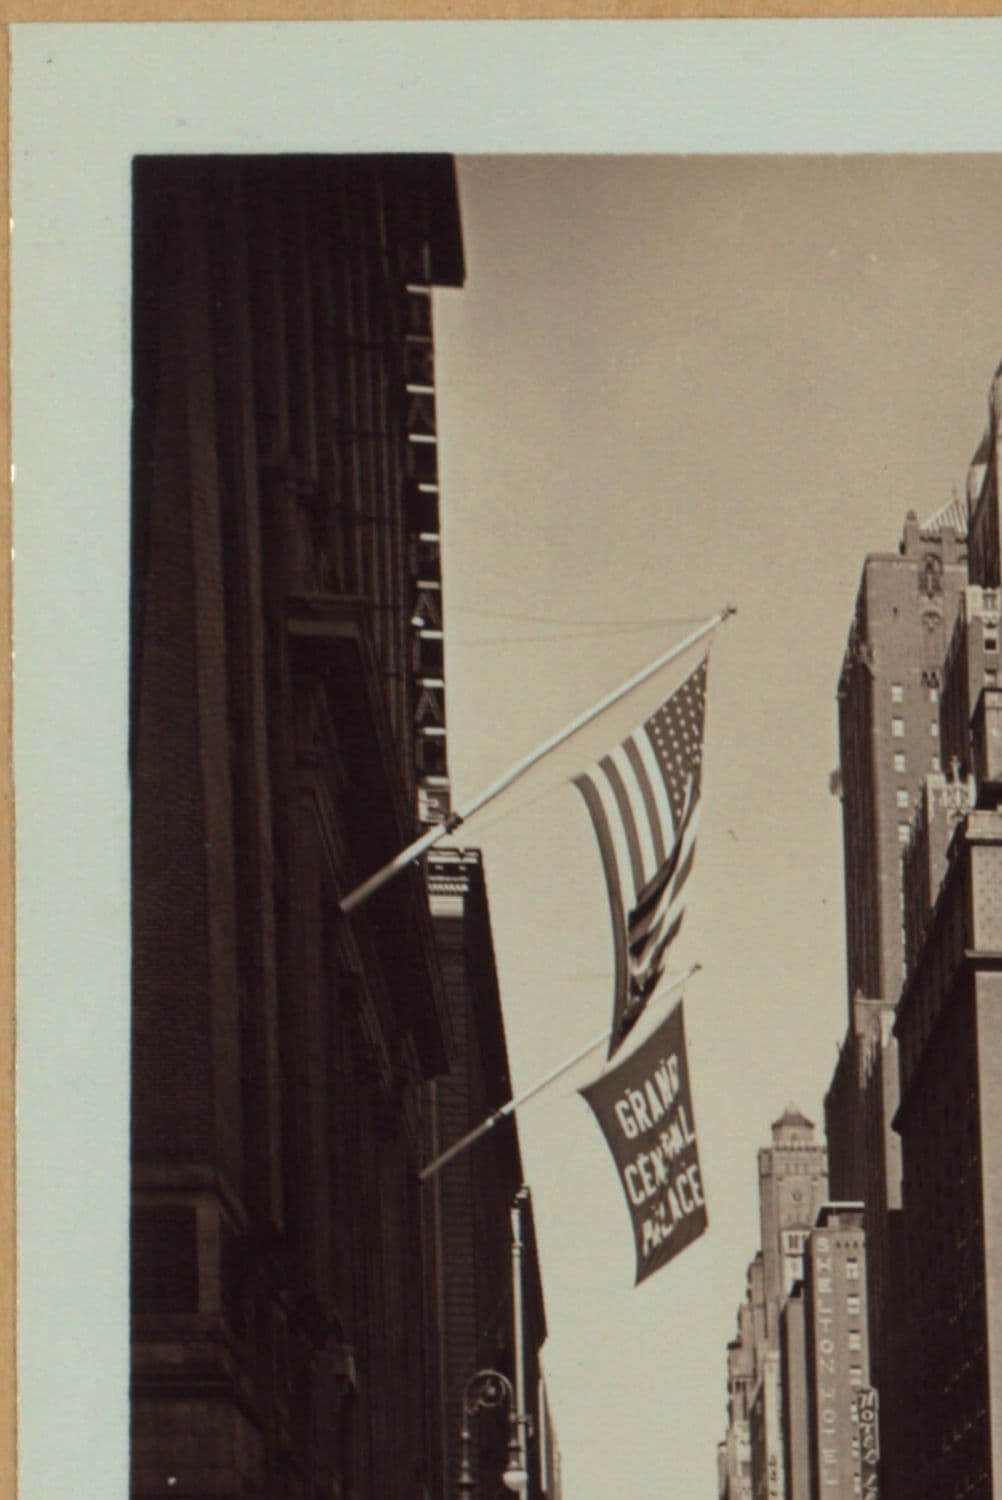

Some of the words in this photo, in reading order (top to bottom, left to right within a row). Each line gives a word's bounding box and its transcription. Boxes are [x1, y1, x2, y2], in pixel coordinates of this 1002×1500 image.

[614, 1053, 681, 1140] GRAND
[642, 1160, 706, 1257] PALACE
[816, 1236, 835, 1375] SHELTON
[860, 1391, 878, 1465] HOTEL
